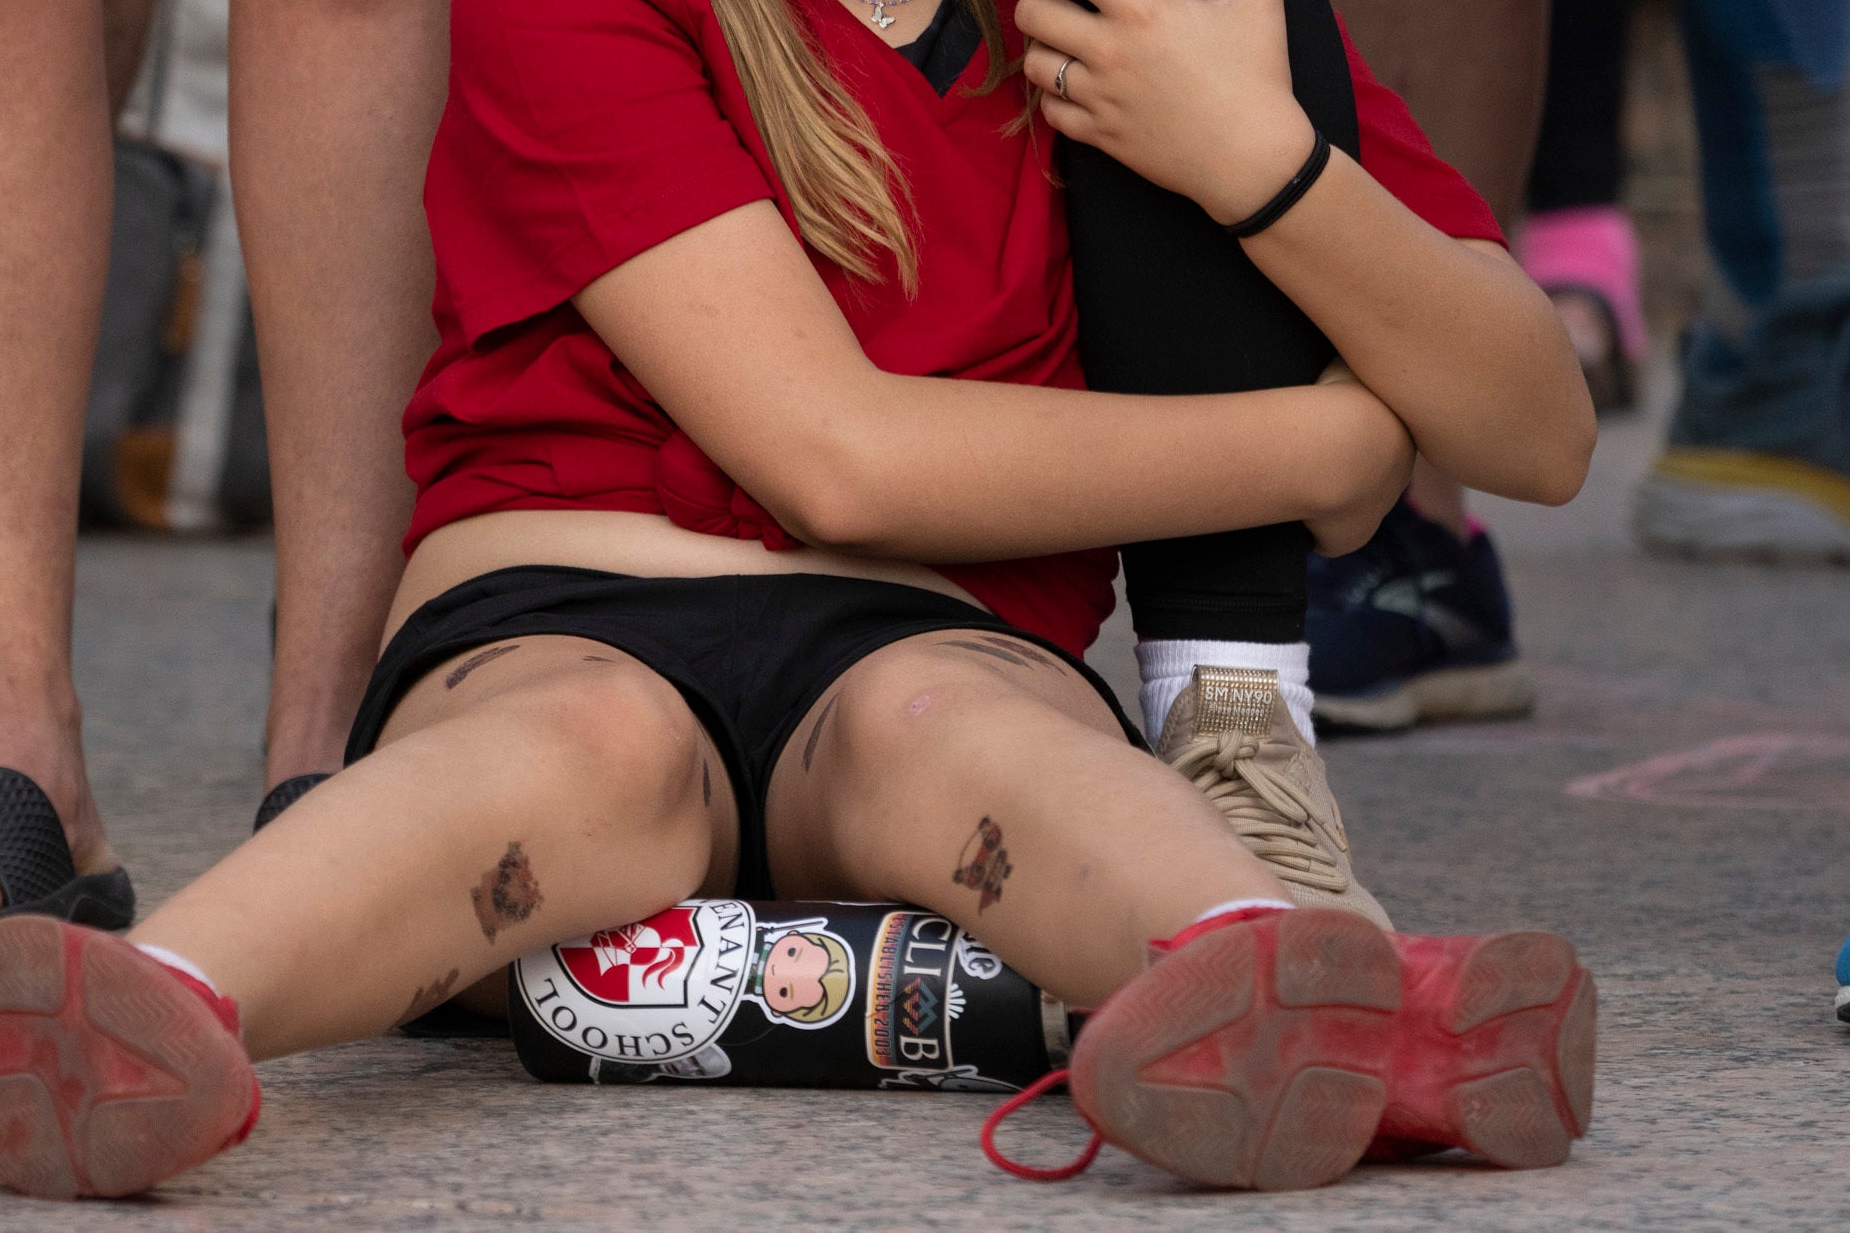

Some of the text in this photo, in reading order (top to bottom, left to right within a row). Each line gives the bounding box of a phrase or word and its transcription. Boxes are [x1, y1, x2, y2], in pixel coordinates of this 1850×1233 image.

[1205, 686, 1273, 705] SM NY90
[534, 901, 746, 1058] ENANT SCHOOL
[875, 1018, 891, 1057] 2003
